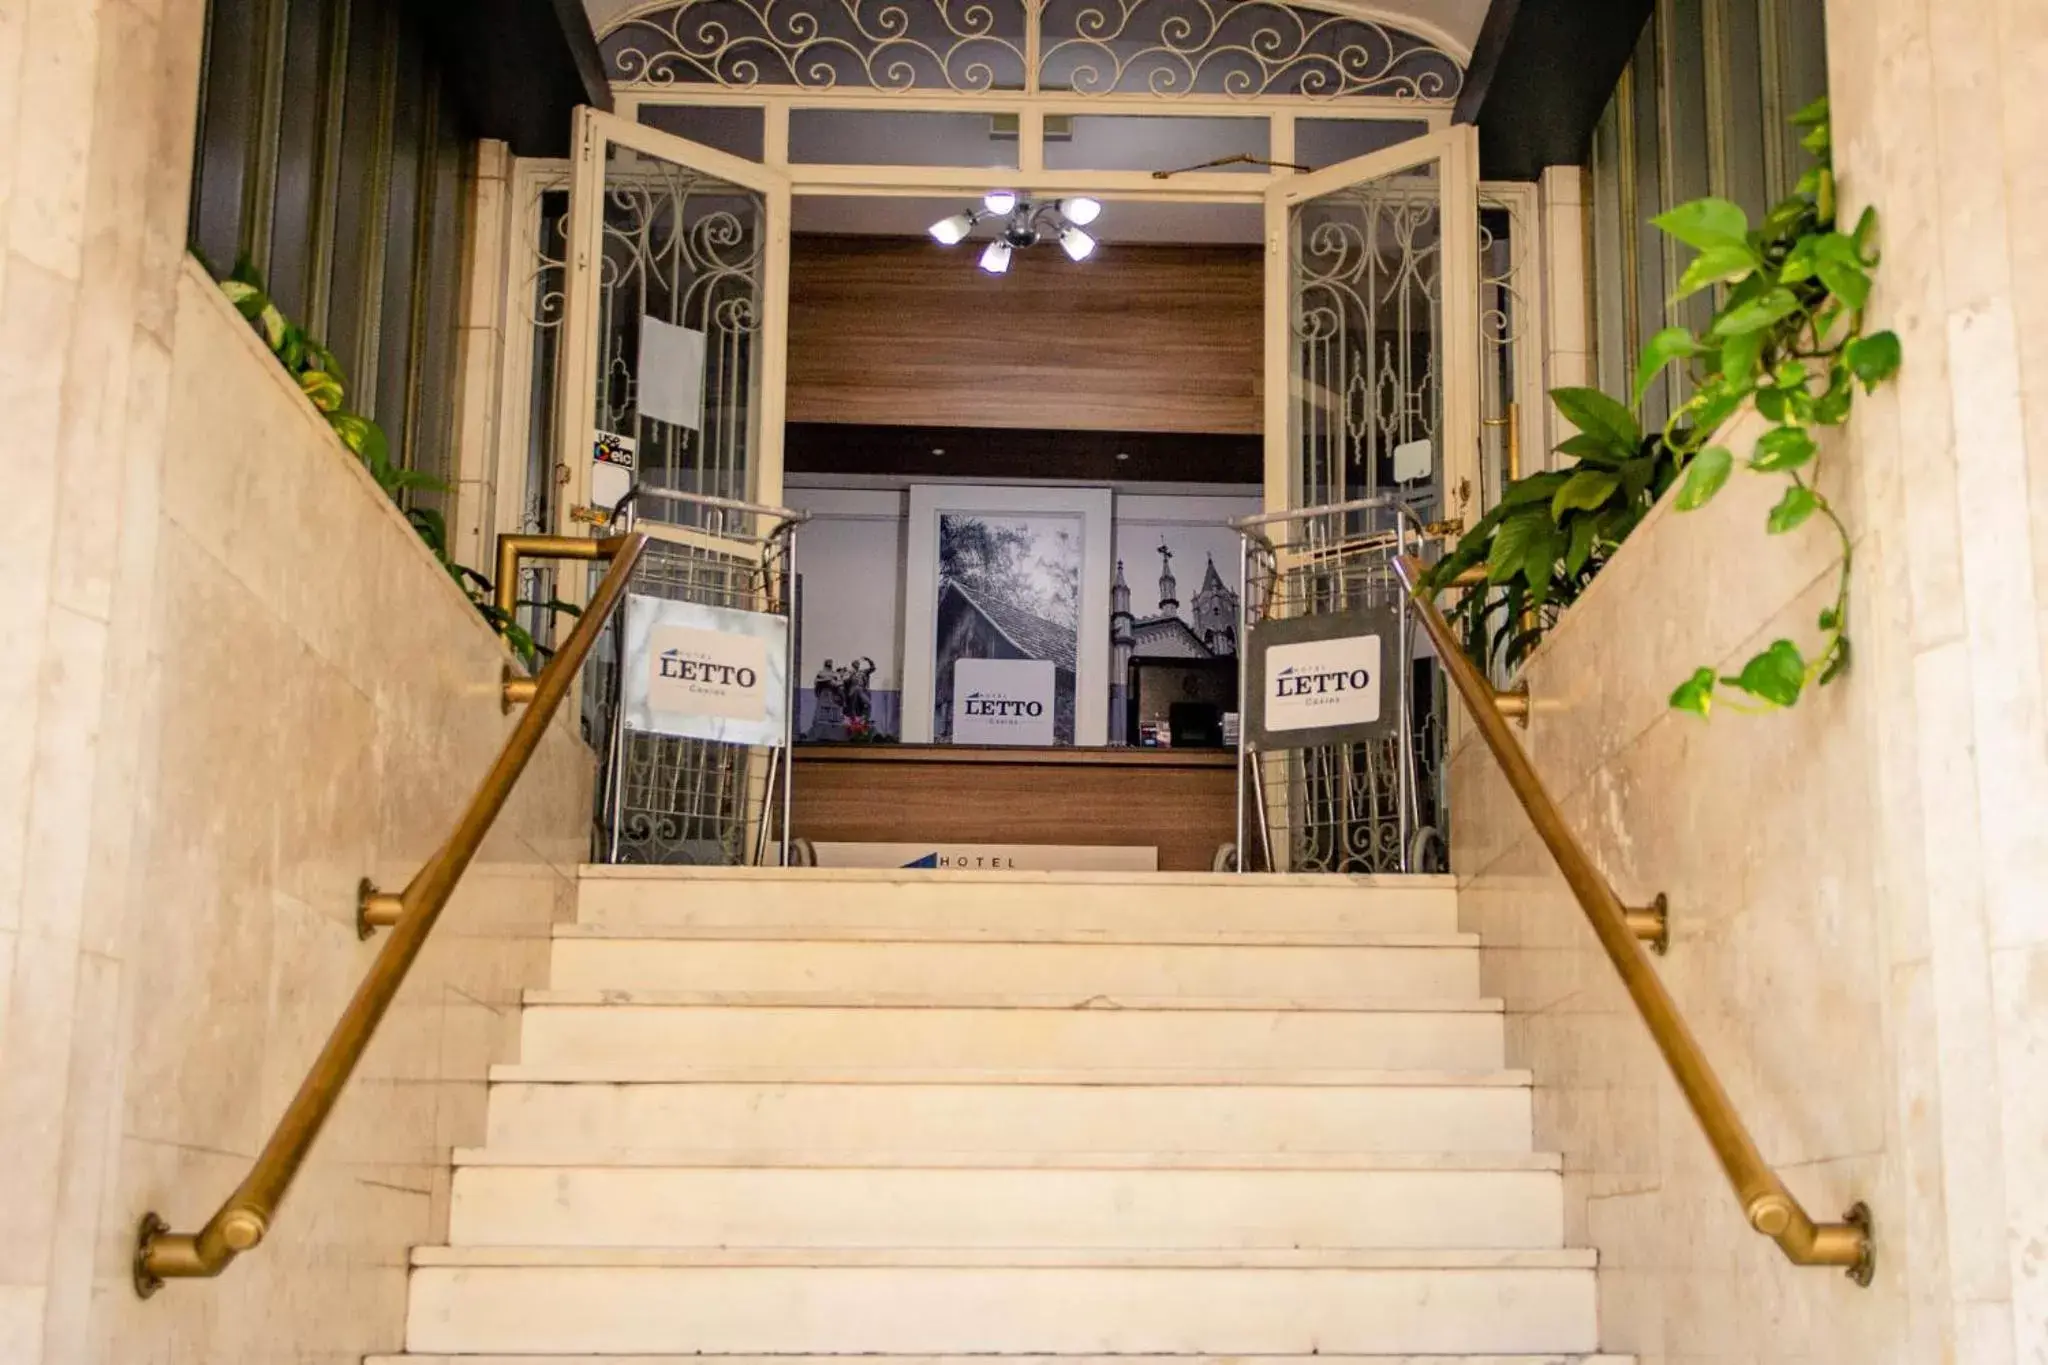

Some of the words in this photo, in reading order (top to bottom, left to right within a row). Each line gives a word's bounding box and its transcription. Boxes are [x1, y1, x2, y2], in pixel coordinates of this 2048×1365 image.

[659, 657, 756, 688] LETTO
[1276, 669, 1369, 697] LETTO
[965, 700, 1043, 717] LETTO
[940, 856, 1015, 868] HOTEL
